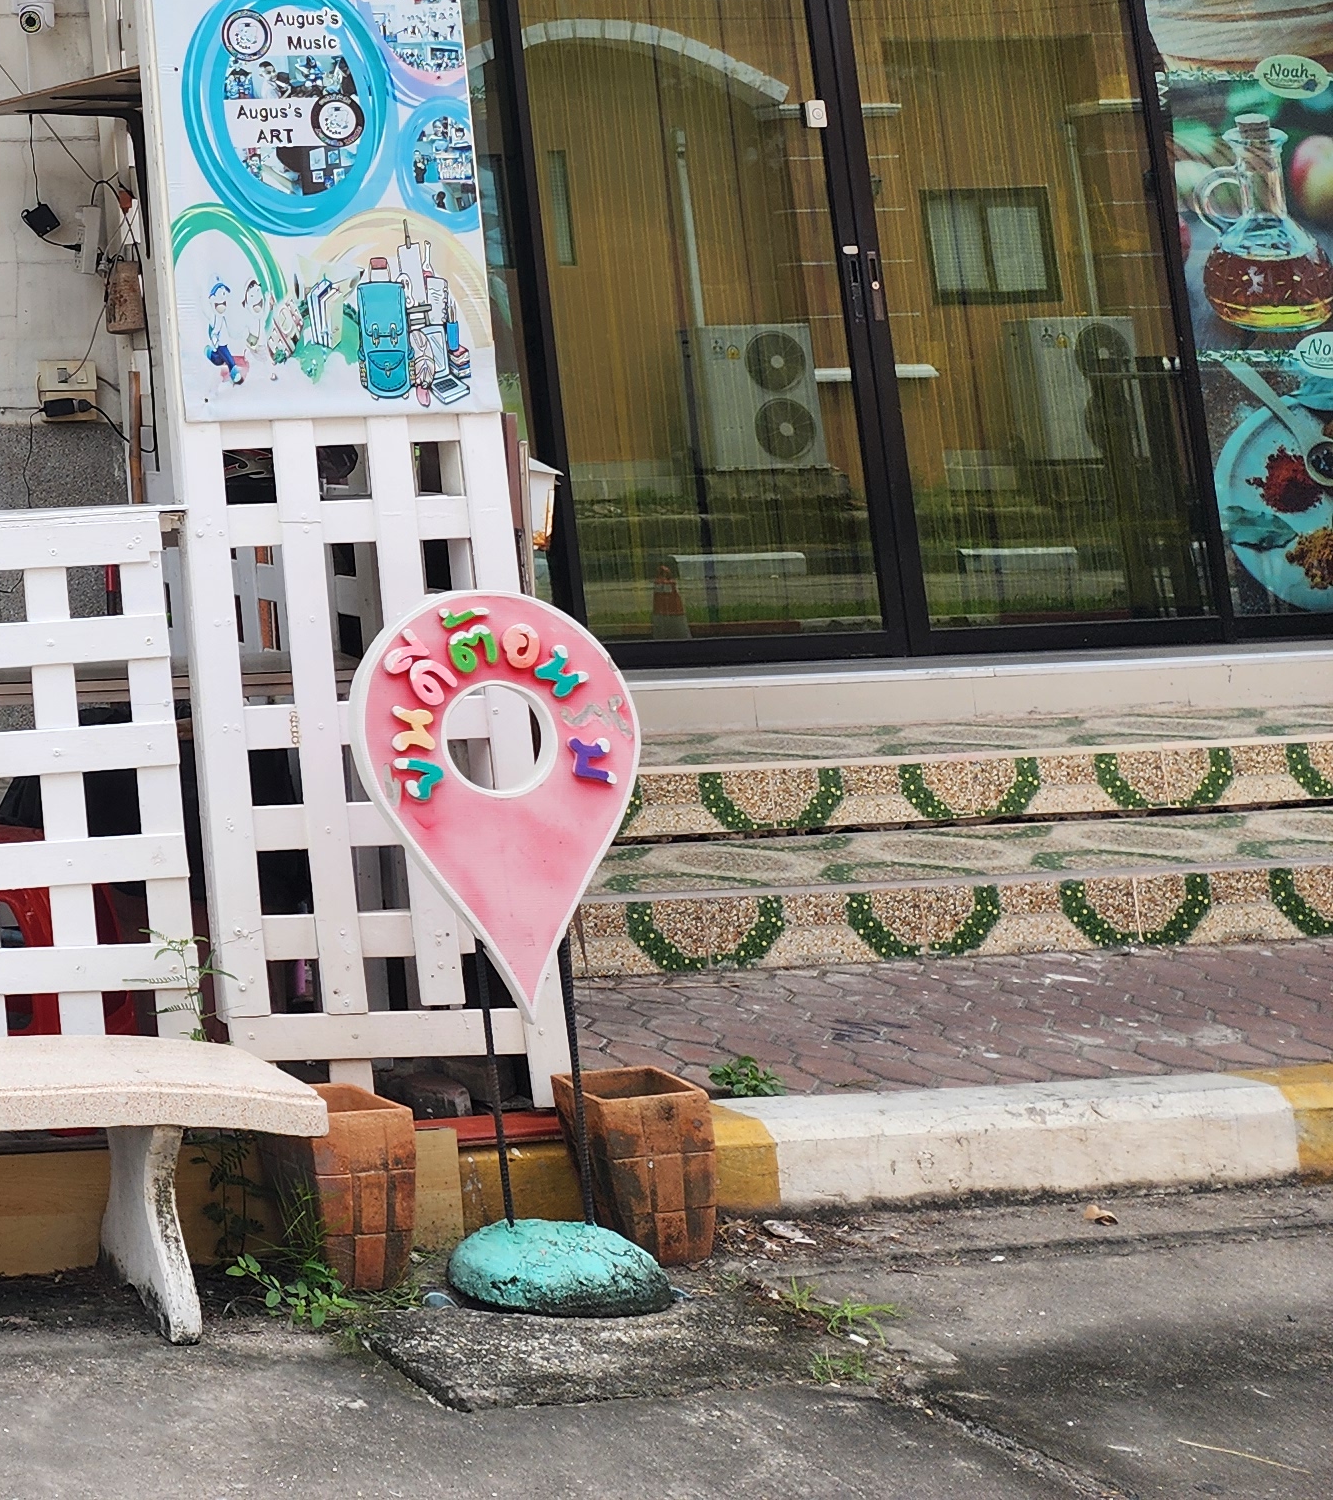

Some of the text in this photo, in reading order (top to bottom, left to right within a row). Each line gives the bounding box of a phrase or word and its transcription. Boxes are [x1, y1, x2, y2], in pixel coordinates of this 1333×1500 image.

[273, 10, 339, 28] Augus's
[287, 35, 338, 50] Music
[1269, 62, 1309, 79] Noah
[236, 104, 303, 122] Augus's
[257, 129, 294, 144] ART
[1308, 338, 1332, 356] No
